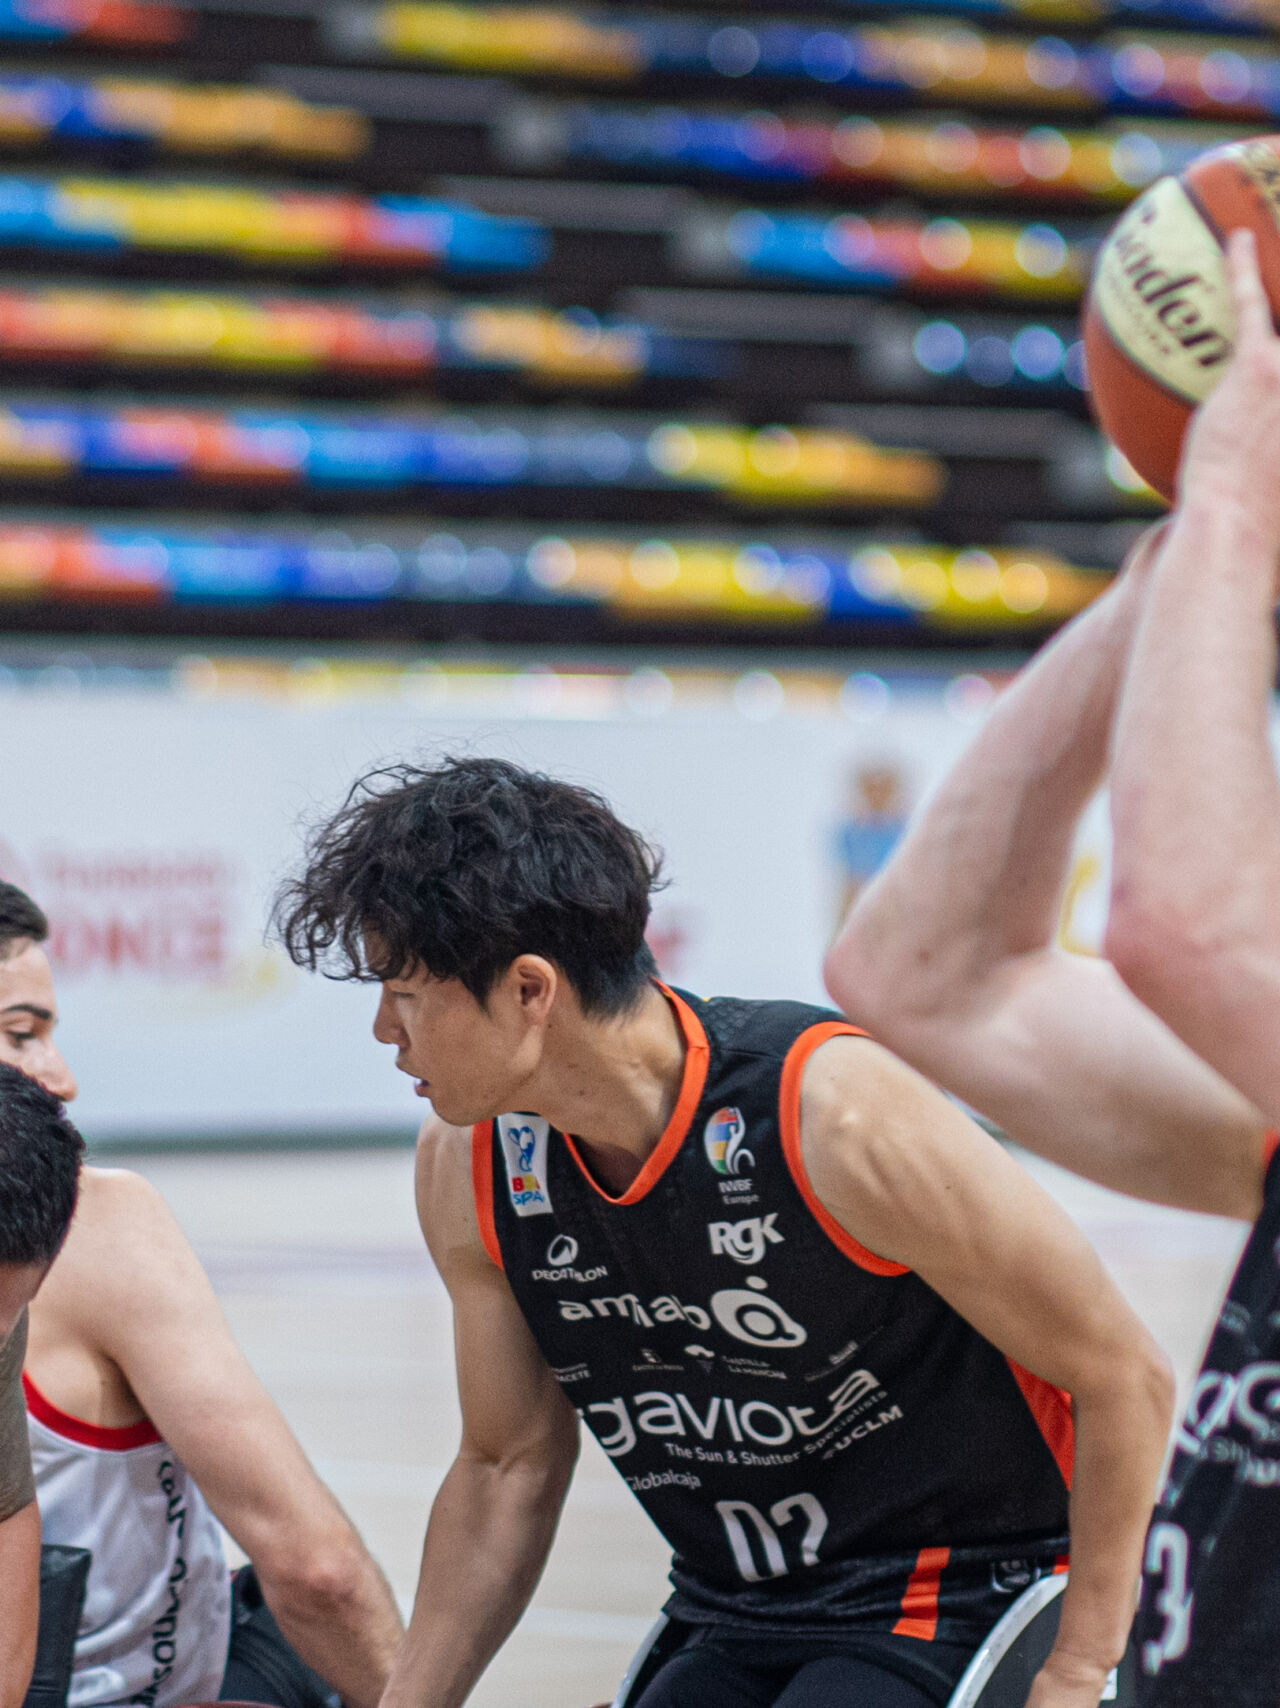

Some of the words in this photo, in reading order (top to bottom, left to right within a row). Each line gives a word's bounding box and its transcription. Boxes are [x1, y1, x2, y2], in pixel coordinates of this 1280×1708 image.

[587, 1368, 881, 1457] gaviota
[834, 1404, 904, 1451] UCLM
[664, 1442, 693, 1460] The
[696, 1446, 724, 1464] Sun
[727, 1449, 739, 1465] &
[741, 1450, 800, 1466] Shutter
